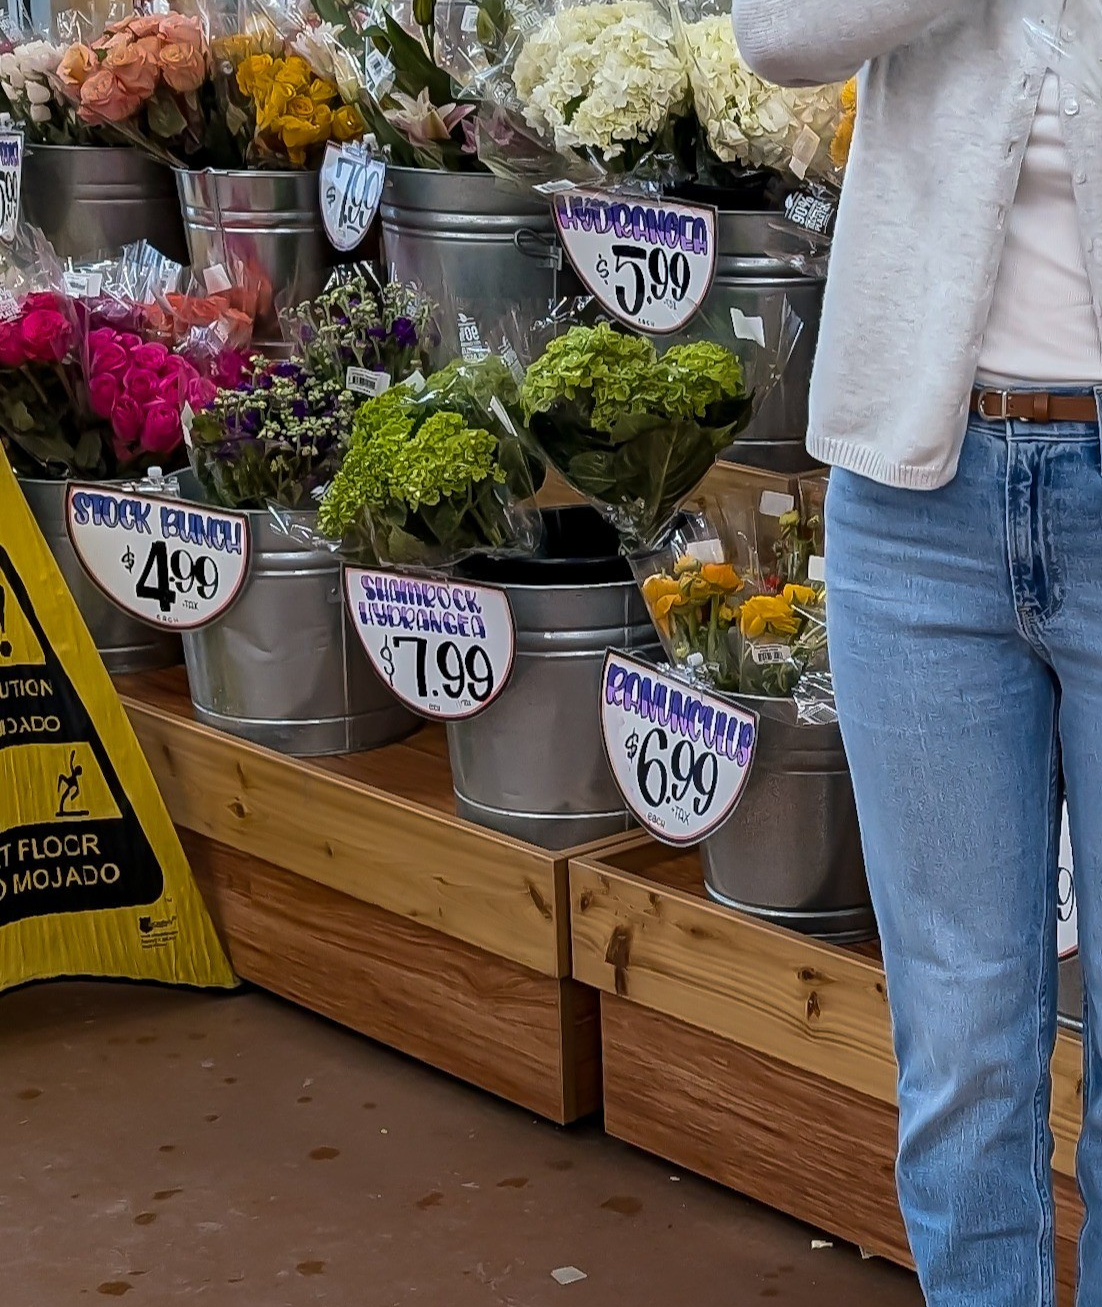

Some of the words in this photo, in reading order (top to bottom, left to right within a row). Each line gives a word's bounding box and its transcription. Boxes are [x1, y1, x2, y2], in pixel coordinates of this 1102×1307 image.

[72, 491, 152, 535] STOCK
[160, 505, 242, 555] BUNCH
[360, 575, 482, 615] SHAMROCK
[358, 601, 487, 639] HYDRANGEA
[605, 662, 755, 767] RANUNCULUS
[18, 833, 102, 862] FLOOR
[13, 863, 121, 894] MOJADO
